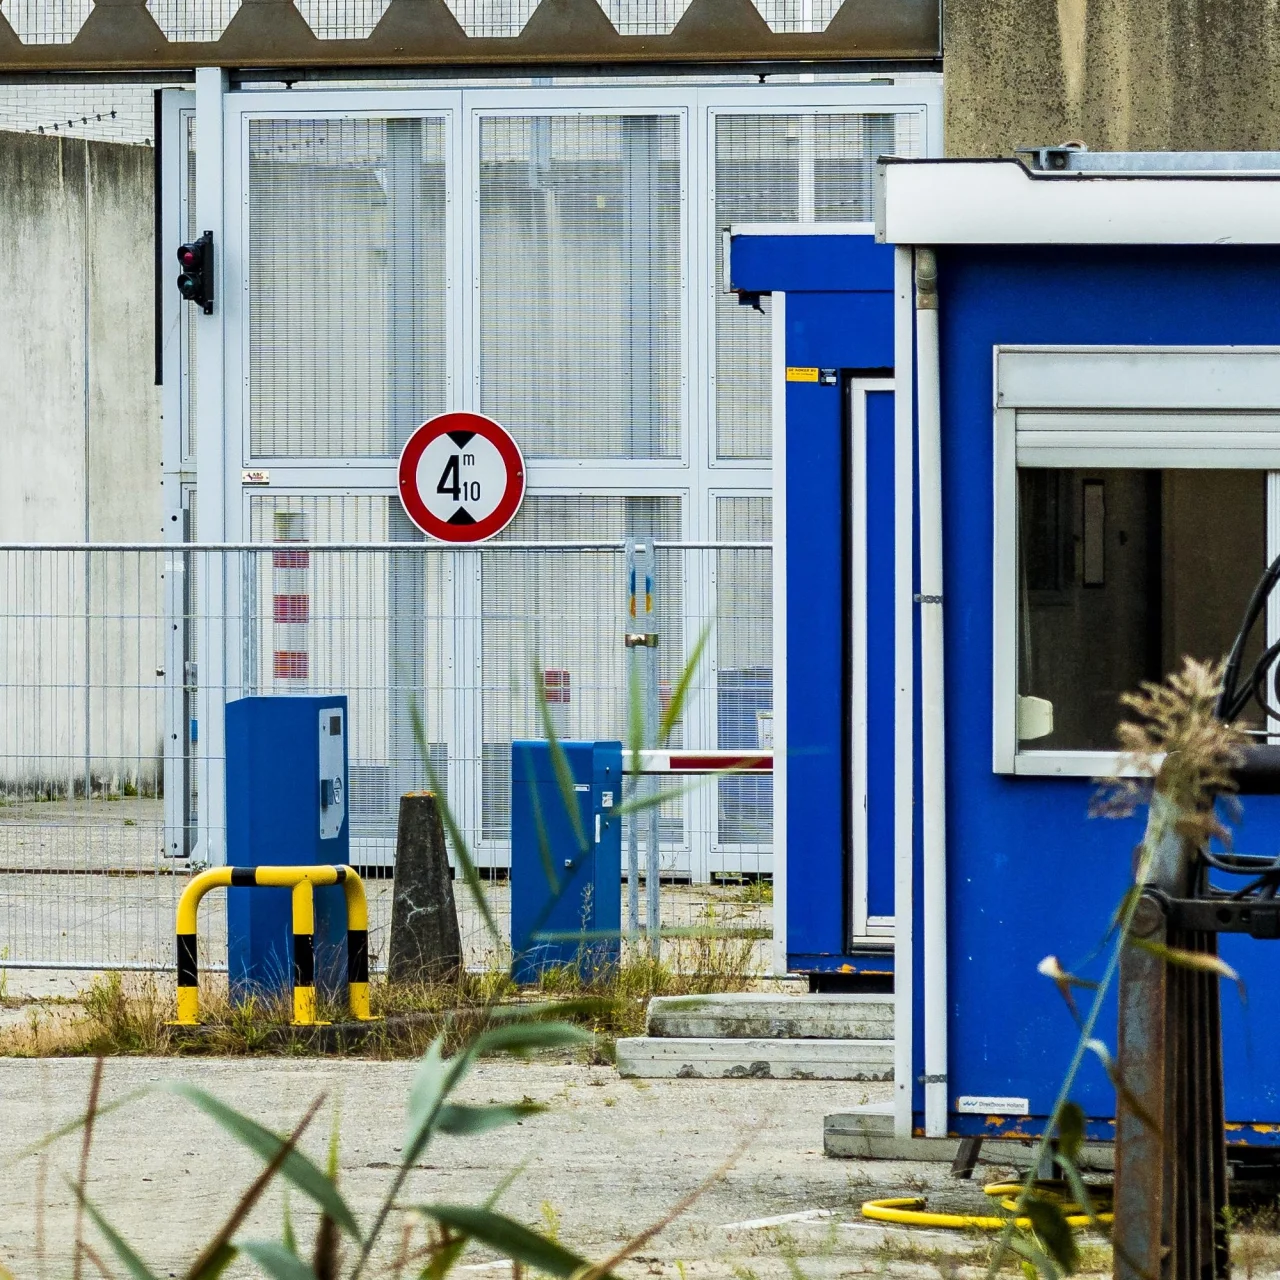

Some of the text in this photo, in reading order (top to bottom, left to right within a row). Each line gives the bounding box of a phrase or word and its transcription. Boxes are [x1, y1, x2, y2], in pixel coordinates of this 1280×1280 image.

[437, 454, 481, 501] 4 m 10
